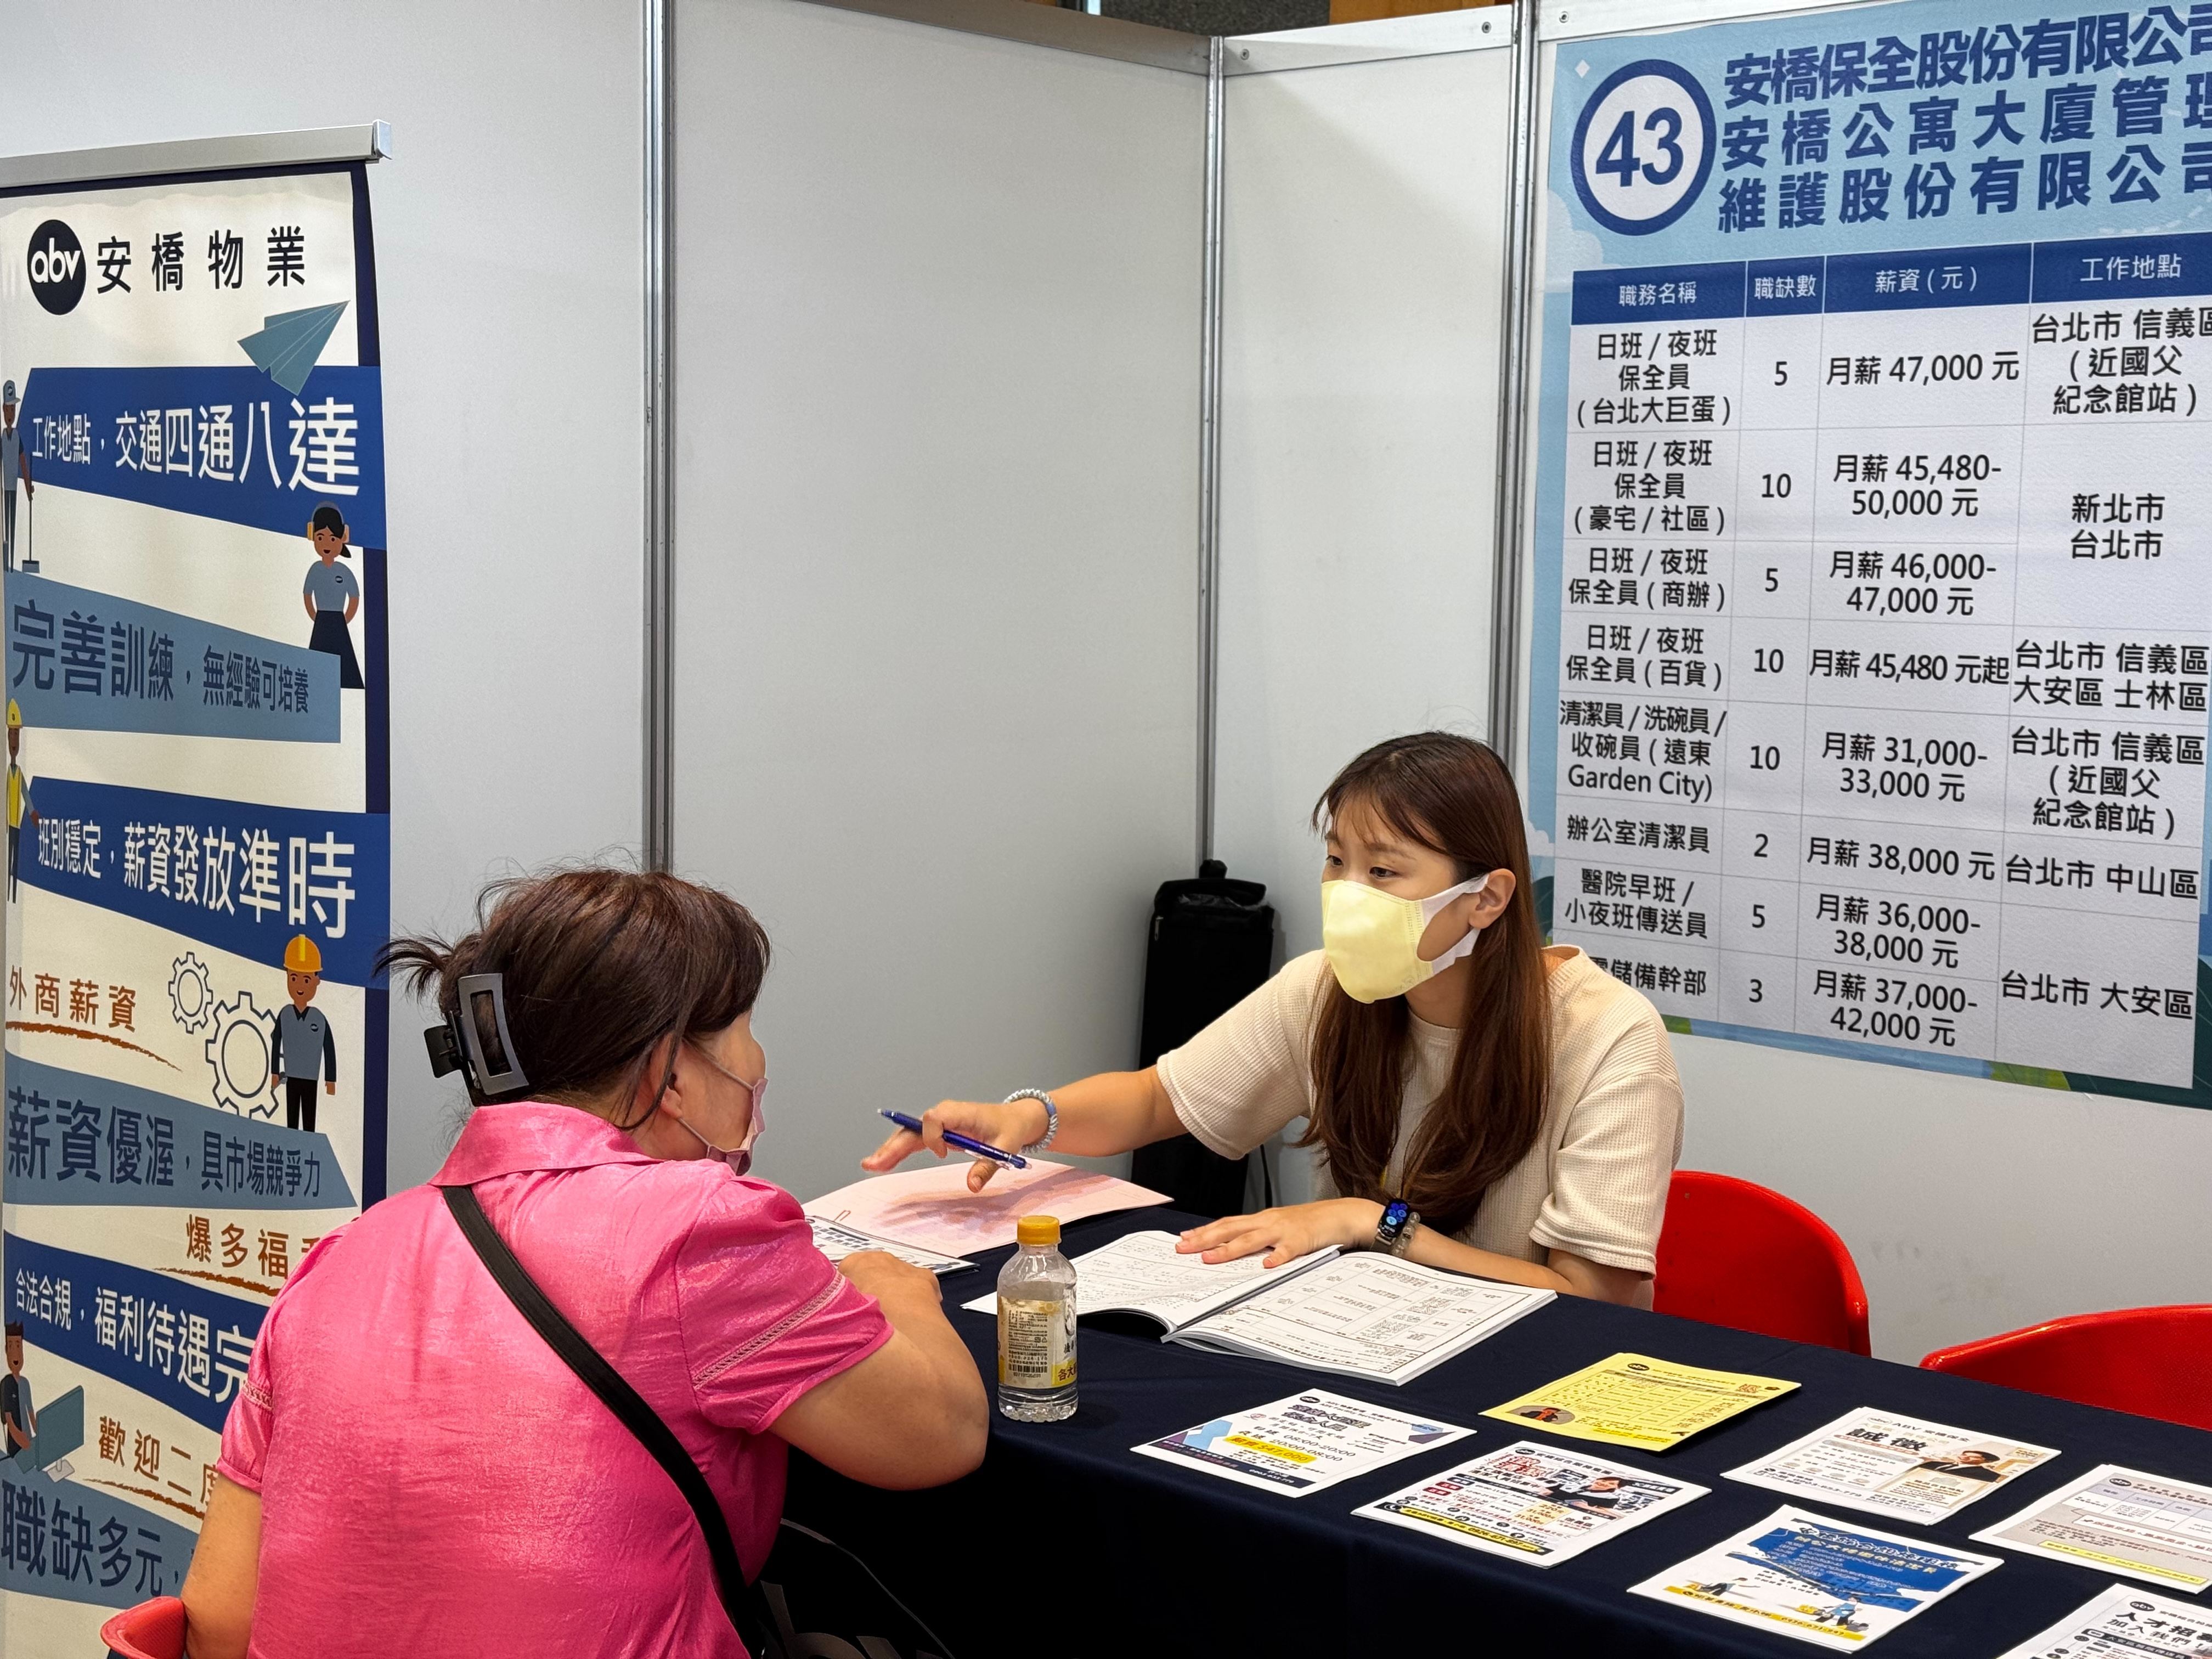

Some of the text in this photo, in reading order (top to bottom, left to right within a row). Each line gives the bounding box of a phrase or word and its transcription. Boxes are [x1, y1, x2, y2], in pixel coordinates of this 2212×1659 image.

[1595, 107, 1684, 188] 43
[31, 238, 81, 283] abv
[97, 225, 305, 294] 安橋物業
[2080, 254, 2182, 283] 工作地點
[1619, 281, 1697, 307] 職務名稱
[1754, 274, 1816, 301] 職缺數
[2032, 311, 2122, 344] 台北市
[1618, 363, 1690, 392] 保全員
[1774, 360, 1788, 386] 5
[1889, 354, 1983, 386] 47,000
[1762, 473, 1792, 498] 10
[1895, 454, 2001, 485] 45,480-
[1615, 472, 1686, 500] 保全員
[1852, 489, 1943, 519] 50,000
[2072, 493, 2165, 524] 新北市
[2070, 529, 2164, 561] 台北市
[1764, 568, 1779, 592] 5
[1891, 553, 1997, 583] 46,000-
[1847, 586, 1938, 617] 47,000
[1754, 648, 1785, 674] 10
[1865, 653, 1948, 683] 45,480
[1954, 654, 2010, 685] 元起
[2015, 639, 2209, 676] 台北市 信義區
[2013, 675, 2208, 712] 大安區 士林區
[1750, 746, 1781, 771] 10
[1883, 737, 1988, 768] 31,000-
[2011, 725, 2205, 765] 台北市 信義區
[1568, 764, 1713, 804] Garden City)
[1840, 768, 1930, 800] 33,000
[1567, 814, 1710, 854] 辦公室清潔員
[1753, 833, 1769, 857] 2
[1868, 843, 1959, 876] 38,000
[2005, 854, 2199, 901] 台北市 中山區
[1565, 898, 1708, 940] 小夜班傳送員
[1751, 904, 1766, 928] 5
[1877, 900, 1980, 935] 36,000-
[1833, 929, 1923, 963] 38,000
[9, 964, 136, 1032] 外商薪資
[1748, 979, 1763, 1003] 3
[1874, 978, 1978, 1014] 37,000-
[2001, 969, 2194, 1020] 台北市 大安區
[1830, 1006, 1920, 1041] 42,000
[2, 1479, 195, 1596] 職缺多元，
